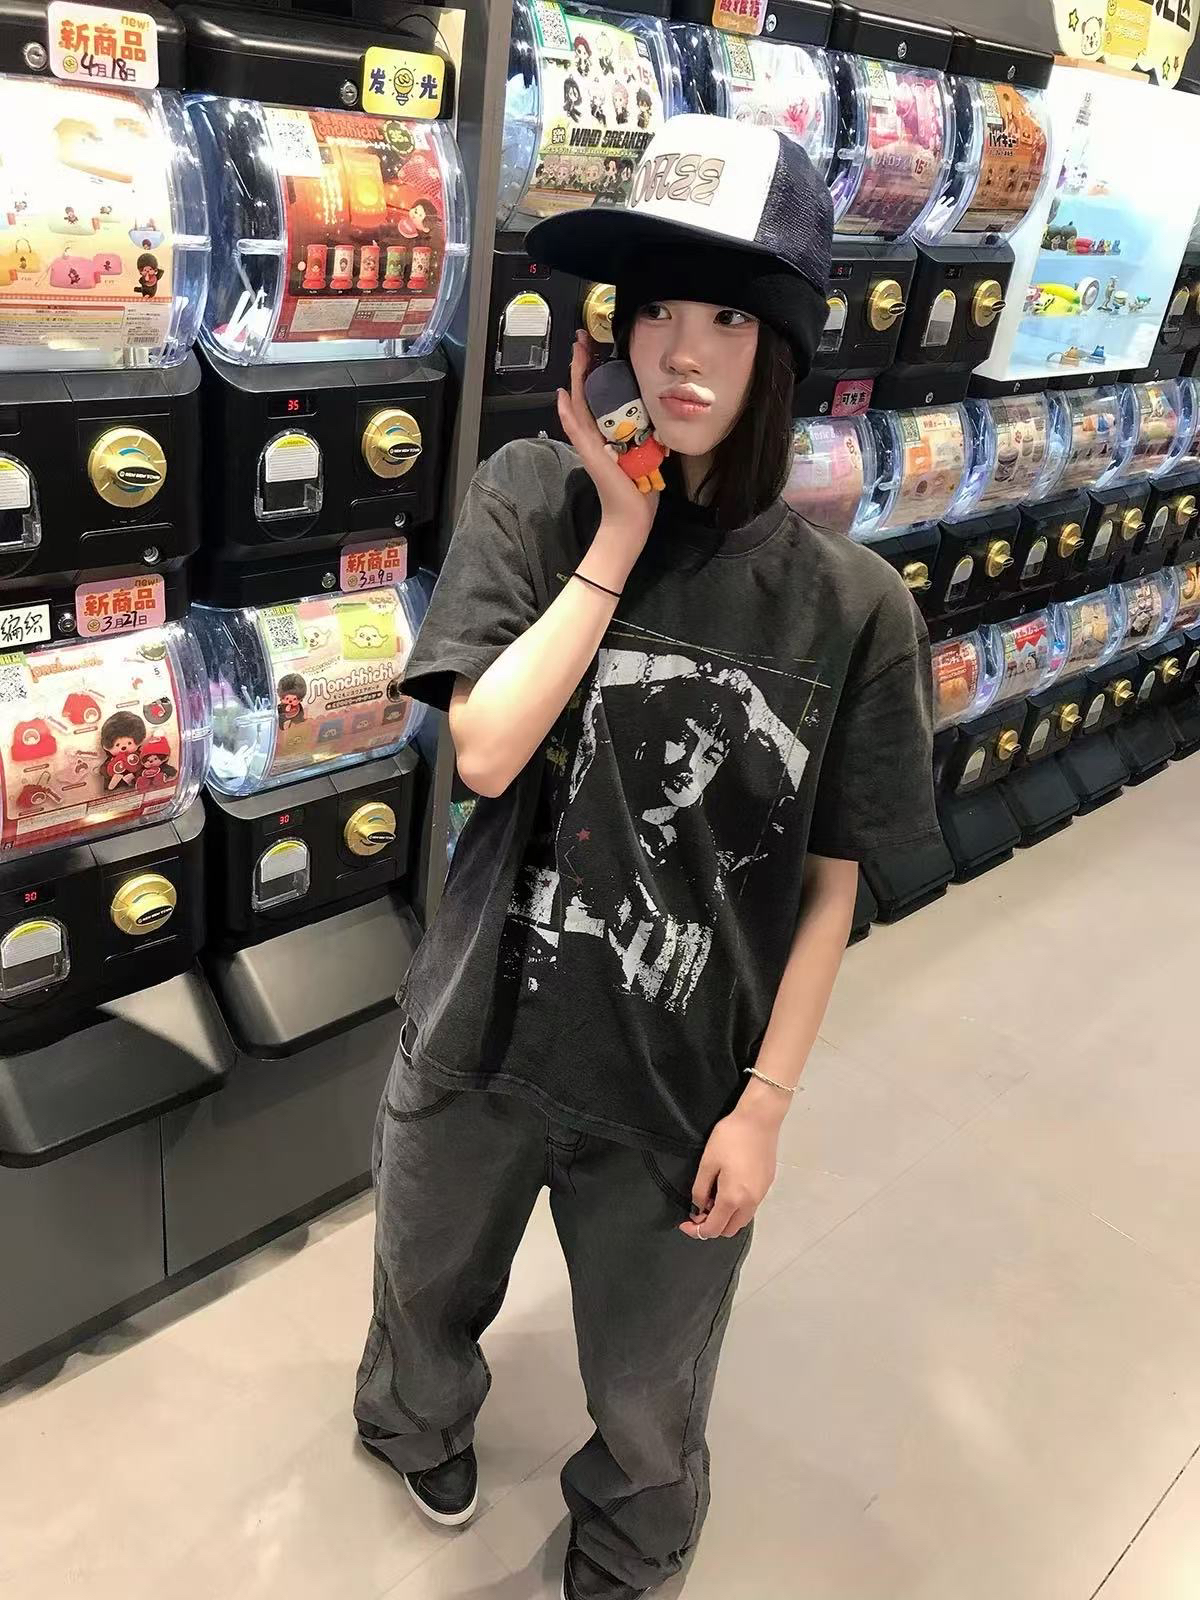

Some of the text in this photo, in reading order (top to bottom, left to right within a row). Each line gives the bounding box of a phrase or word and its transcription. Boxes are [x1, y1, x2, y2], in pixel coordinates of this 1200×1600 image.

[121, 14, 150, 30] new!
[60, 19, 147, 62] 新商品
[80, 53, 137, 81] 4月18日
[569, 128, 602, 148] WIND
[601, 130, 649, 150] BREAKER
[287, 399, 299, 411] 35
[346, 548, 400, 575] 新商品
[134, 578, 159, 587] new!
[358, 569, 393, 588] 3月9日
[84, 588, 156, 616] 新商品
[1, 611, 43, 642] 编织
[101, 610, 148, 633] 3月27日
[308, 662, 394, 704] Monchhichi
[279, 814, 290, 825] 30
[24, 891, 37, 903] 30
